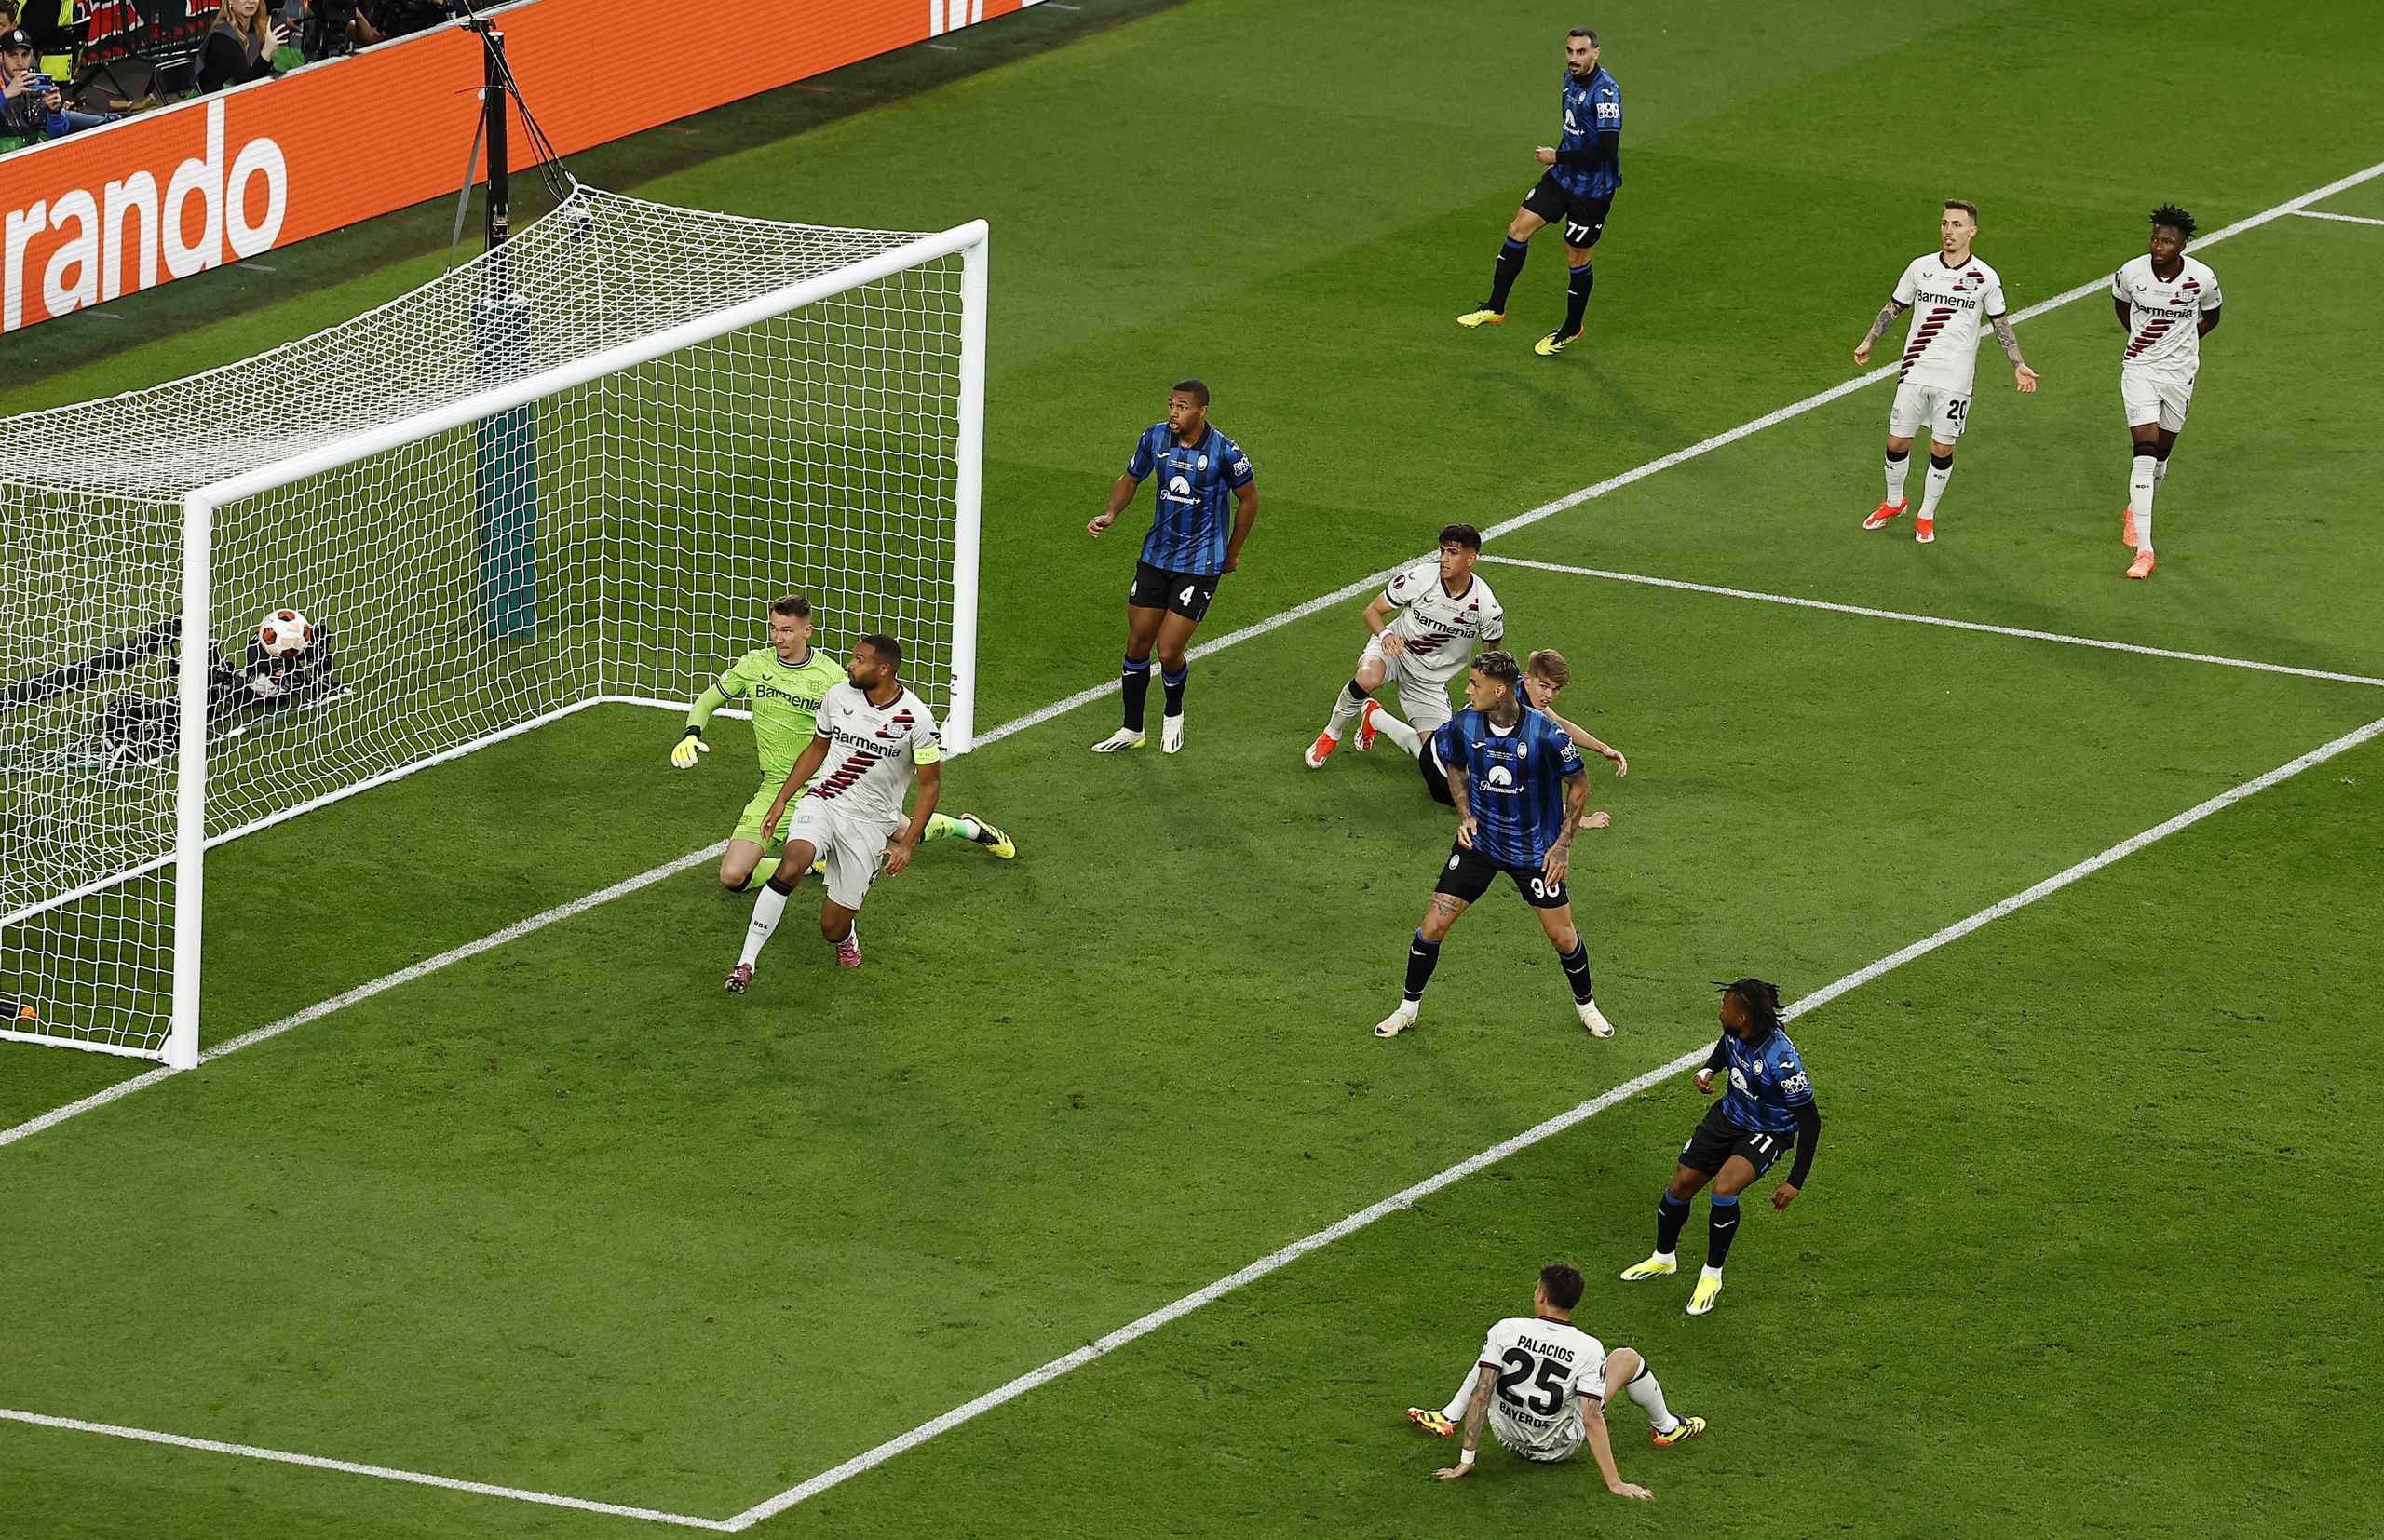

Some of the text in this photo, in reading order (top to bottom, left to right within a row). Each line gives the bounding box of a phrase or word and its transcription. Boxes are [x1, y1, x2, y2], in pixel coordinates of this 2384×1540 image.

[5, 97, 288, 332] rando
[1565, 220, 1590, 242] 77
[1917, 289, 1976, 309] Barmenia
[1946, 399, 1968, 420] 20
[1159, 489, 1201, 505] Paramount+
[1179, 585, 1196, 607] 4
[1413, 608, 1477, 639] Barmenia
[833, 725, 901, 758] Barmenia
[1479, 780, 1525, 795] Paramount+
[1530, 877, 1560, 899] 90
[1749, 1133, 1774, 1154] 11
[1517, 1335, 1575, 1362] PALACIOS
[1496, 1347, 1572, 1416] 25
